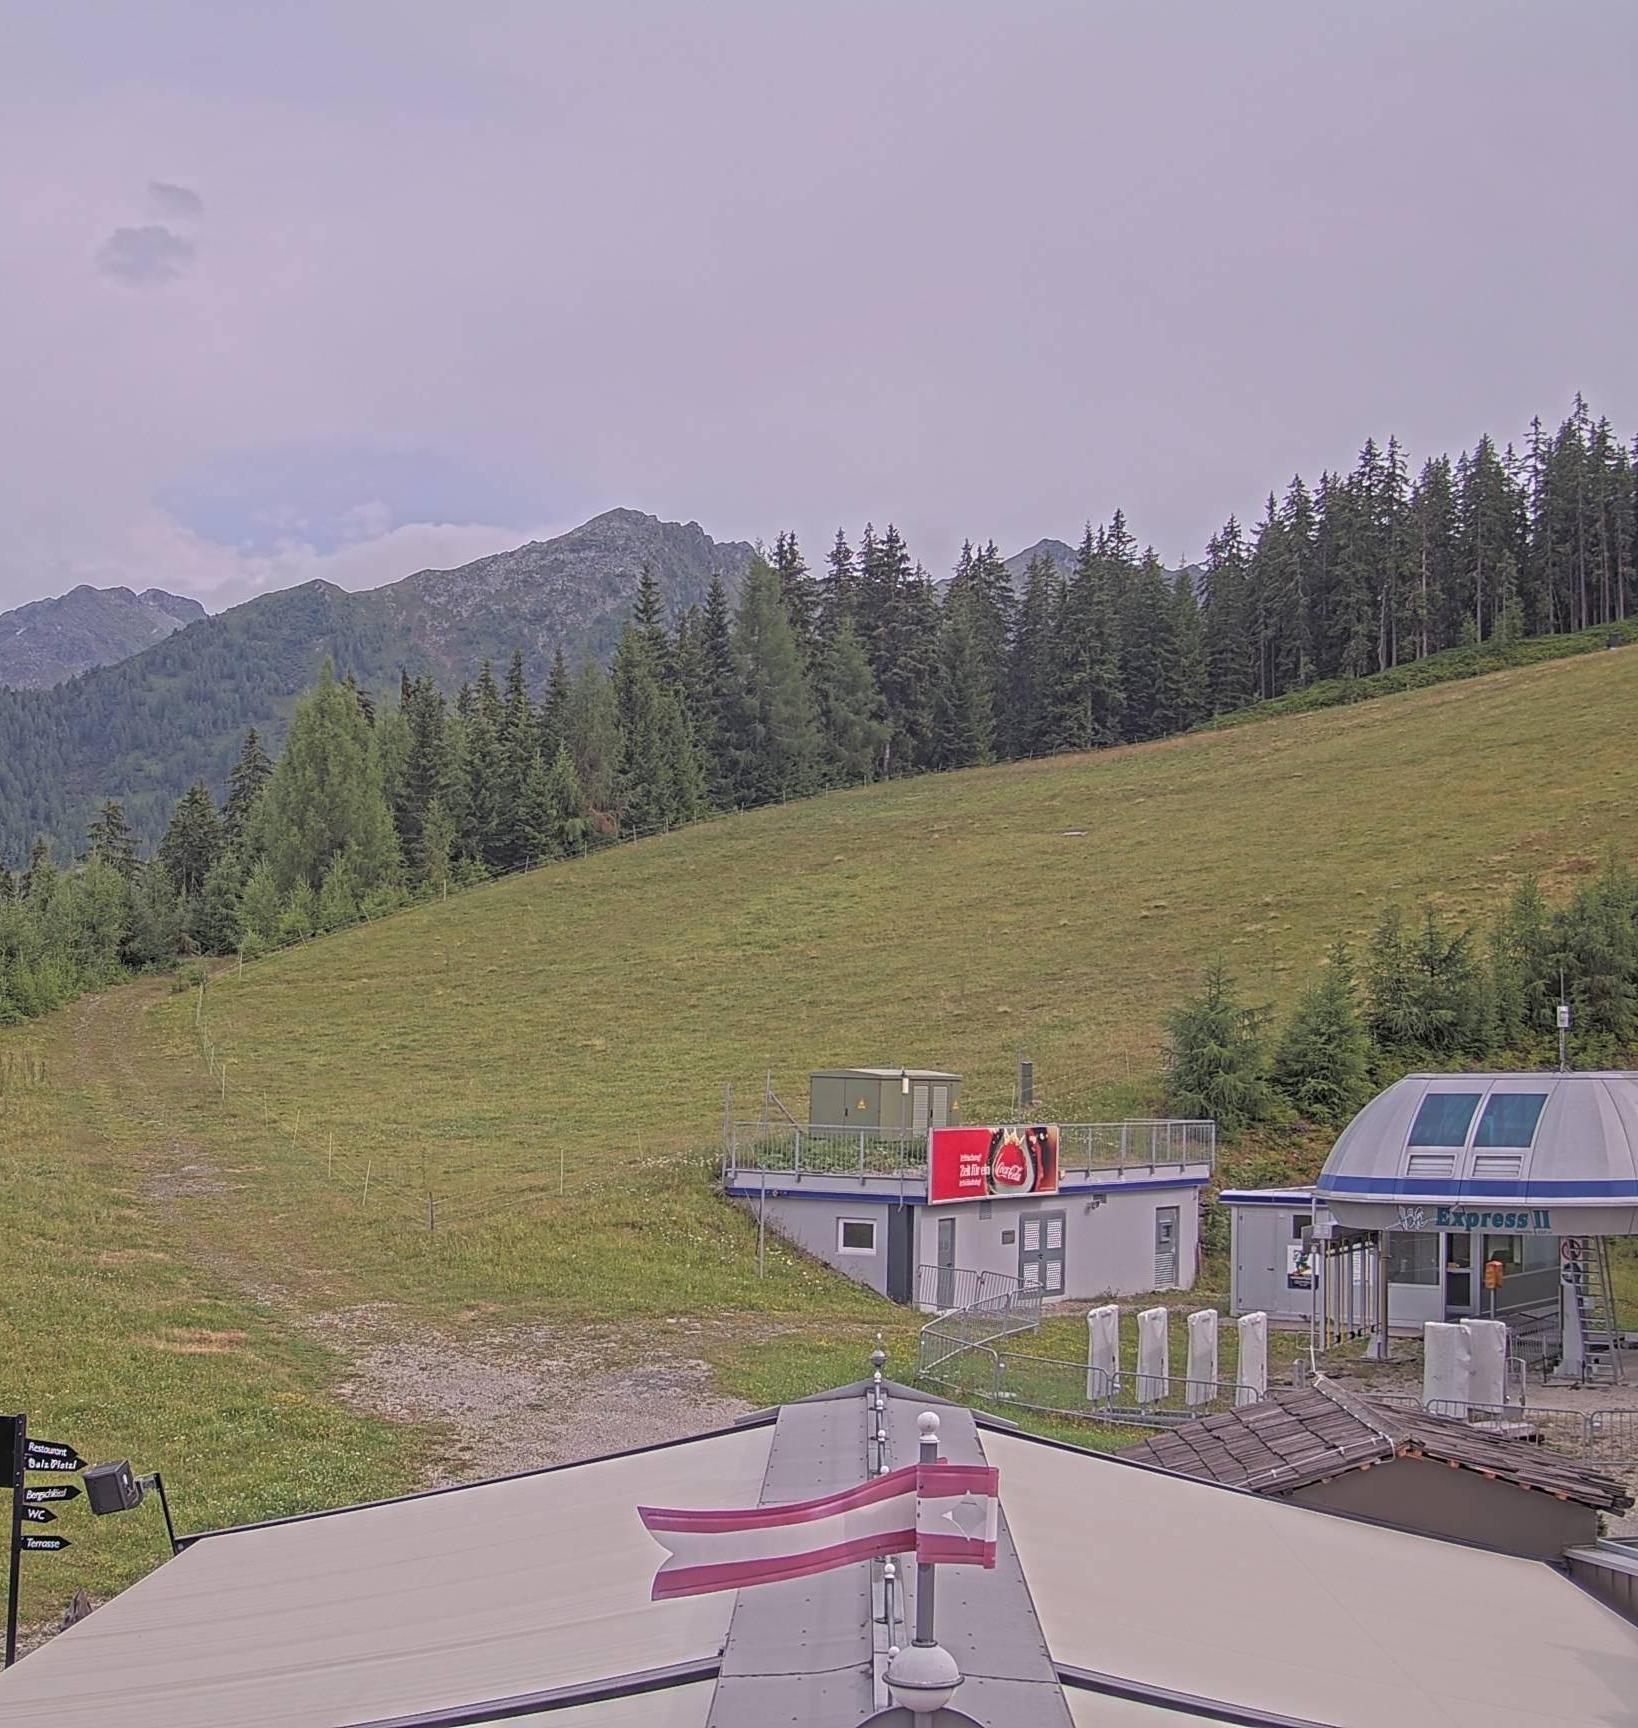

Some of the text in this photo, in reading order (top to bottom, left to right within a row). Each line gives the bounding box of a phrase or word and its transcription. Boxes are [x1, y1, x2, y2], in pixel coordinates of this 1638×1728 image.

[1435, 1206, 1529, 1231] Express
[28, 1441, 67, 1457] Restaurant
[27, 1508, 46, 1520] WC
[26, 1537, 61, 1549] Terrasse
